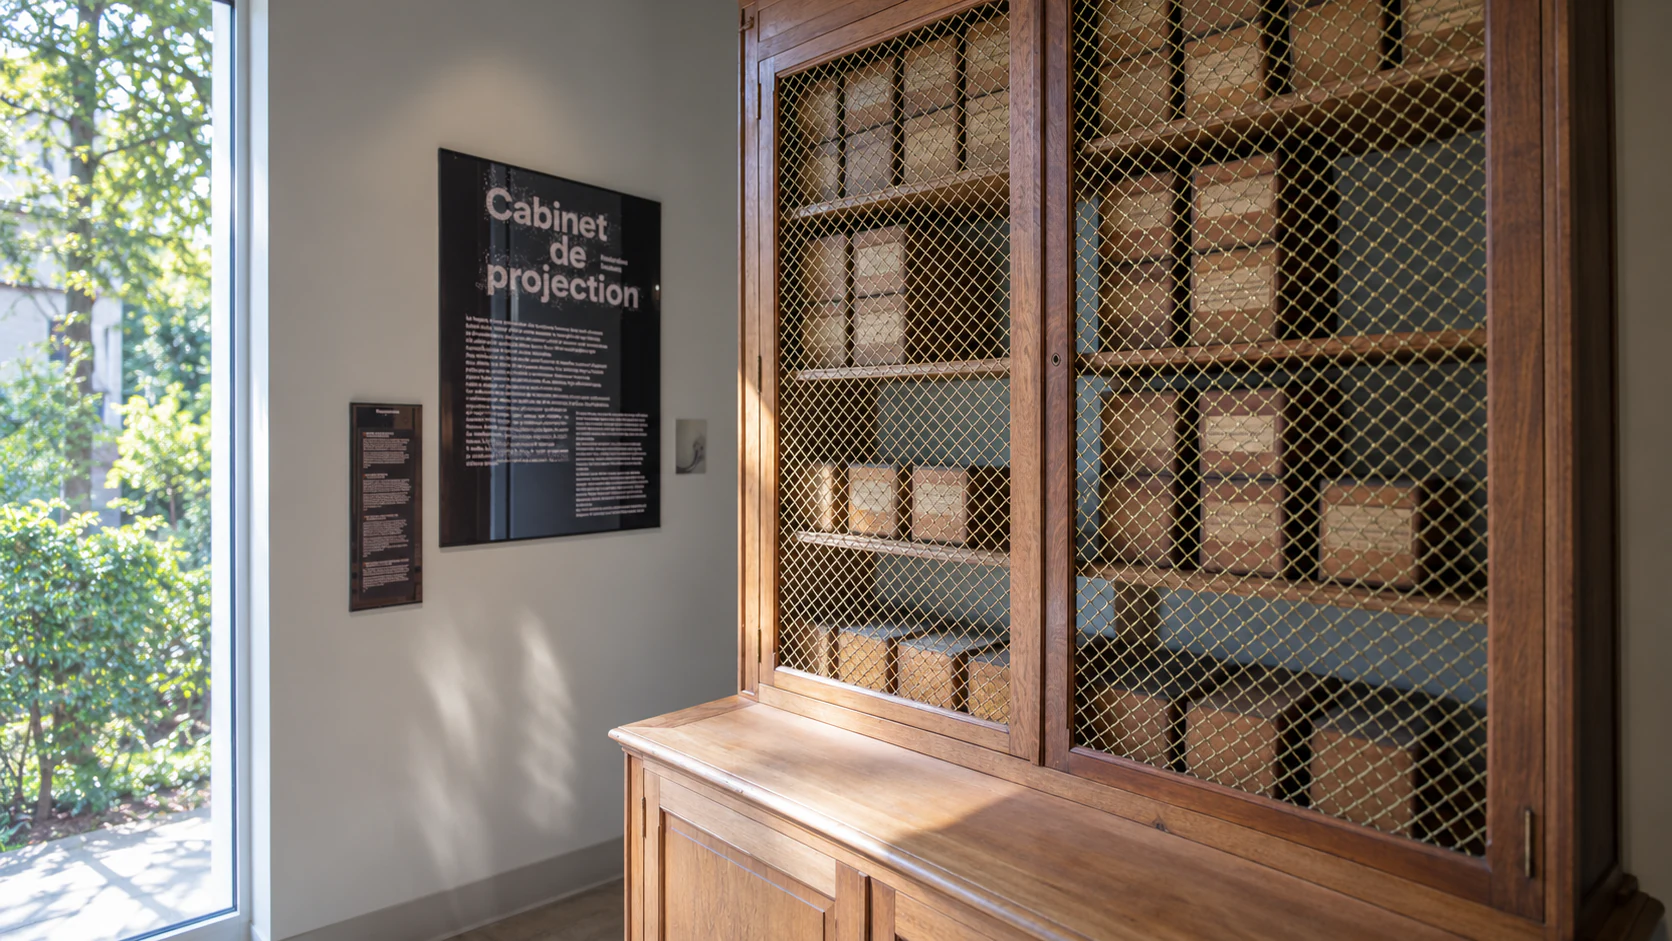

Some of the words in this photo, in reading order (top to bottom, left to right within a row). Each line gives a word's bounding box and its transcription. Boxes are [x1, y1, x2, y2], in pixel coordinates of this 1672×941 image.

[486, 187, 607, 241] Cabinet
[550, 235, 587, 269] de
[487, 263, 639, 309] projection
